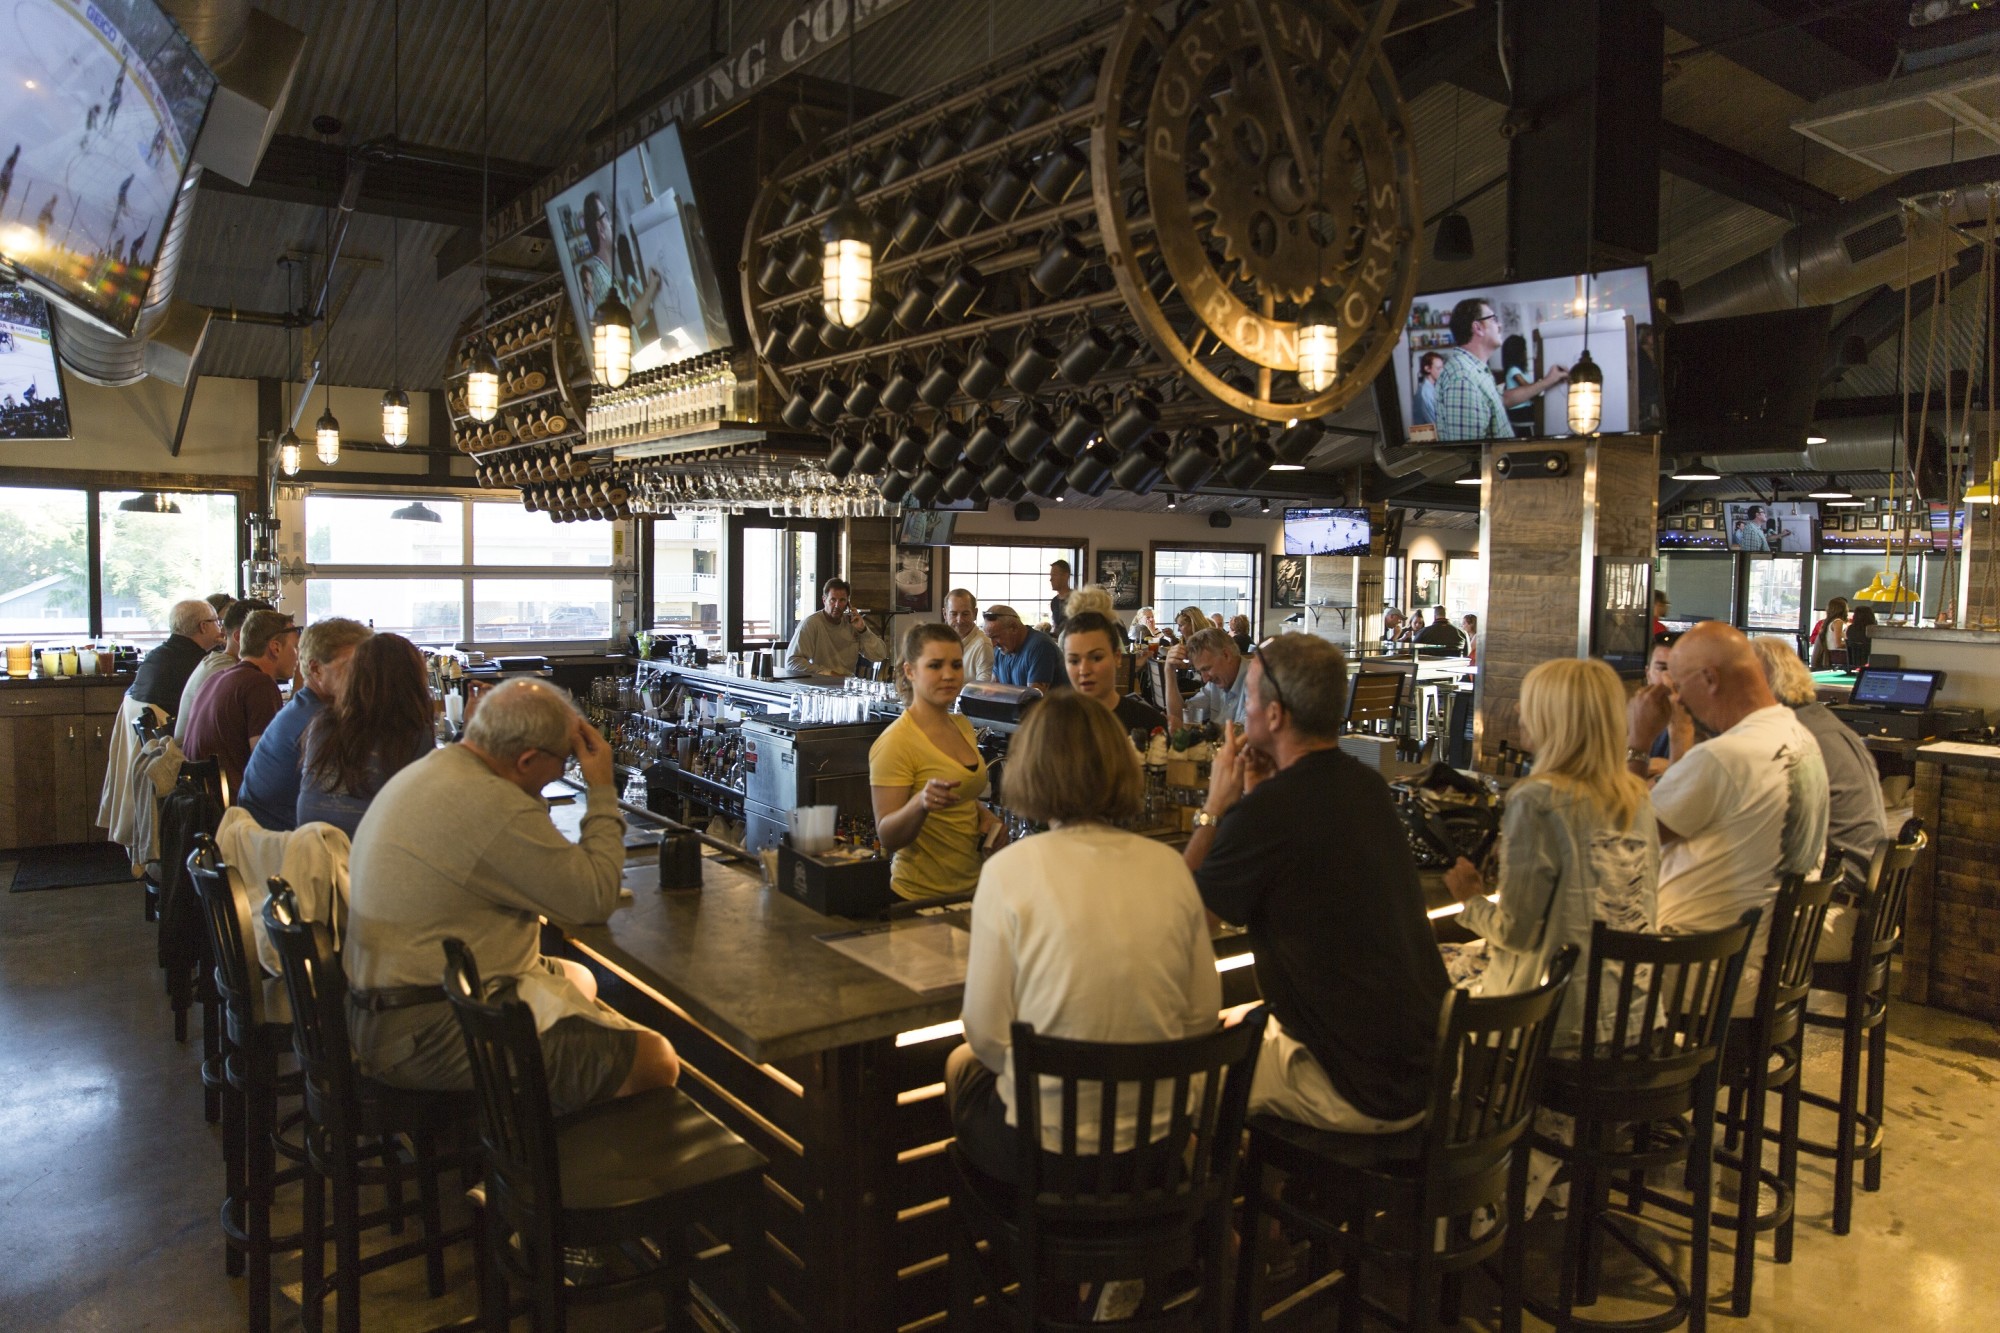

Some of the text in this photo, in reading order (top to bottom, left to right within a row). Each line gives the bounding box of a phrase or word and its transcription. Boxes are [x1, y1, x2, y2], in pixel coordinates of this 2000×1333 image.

[86, 5, 117, 43] GEICO
[1189, 184, 1396, 367] IRON ORKS
